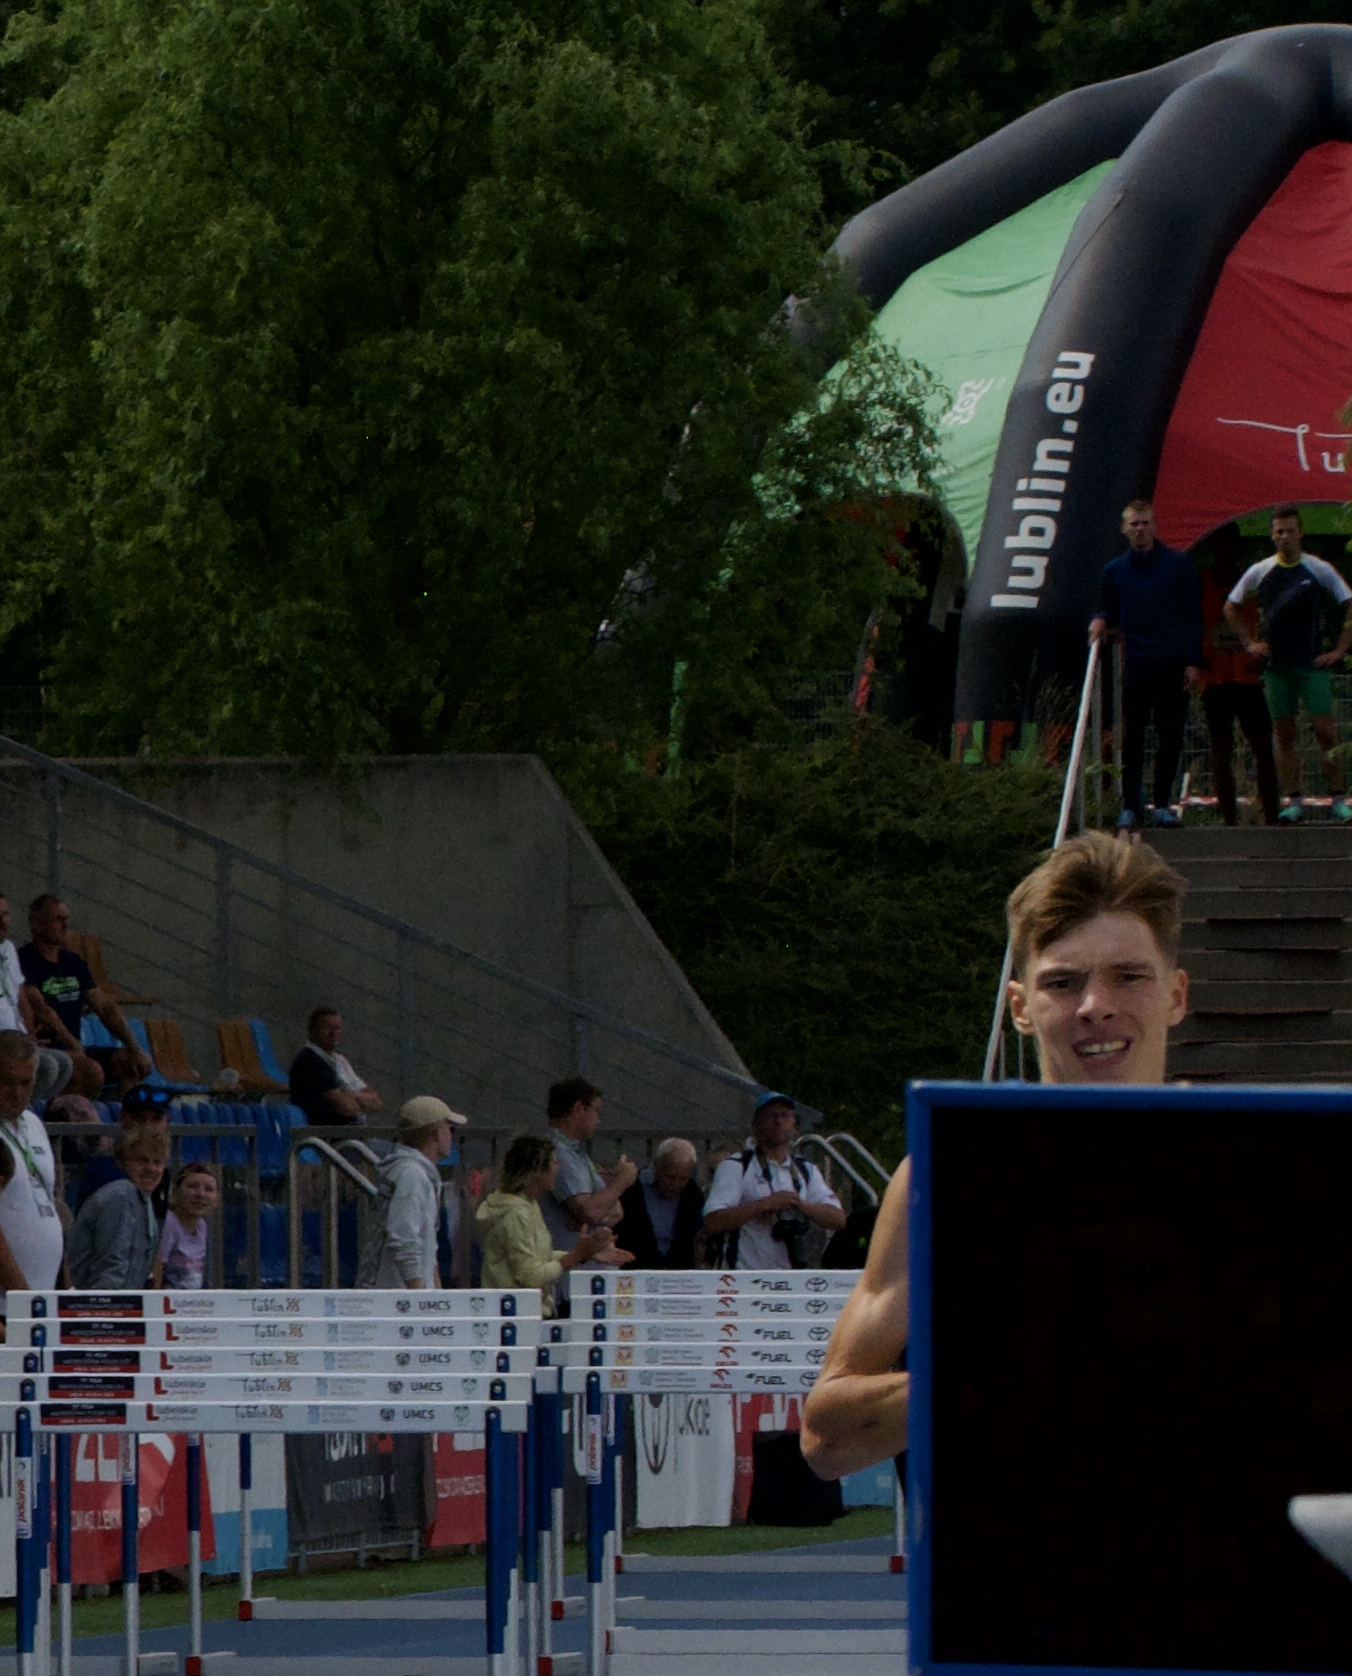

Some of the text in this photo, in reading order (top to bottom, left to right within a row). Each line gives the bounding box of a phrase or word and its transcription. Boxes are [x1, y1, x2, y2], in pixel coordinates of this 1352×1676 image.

[990, 351, 1095, 609] lublin.eu
[761, 1280, 792, 1291] FUEL
[418, 1300, 451, 1311] UMCS
[761, 1303, 792, 1313] FUEL
[422, 1326, 454, 1336] UMCS
[763, 1330, 794, 1340] FUEL
[418, 1353, 451, 1364] UMCS
[760, 1352, 792, 1363] FUEL
[754, 1375, 786, 1385] FUEL
[410, 1381, 443, 1392] UMCS
[402, 1409, 435, 1420] UMCS
